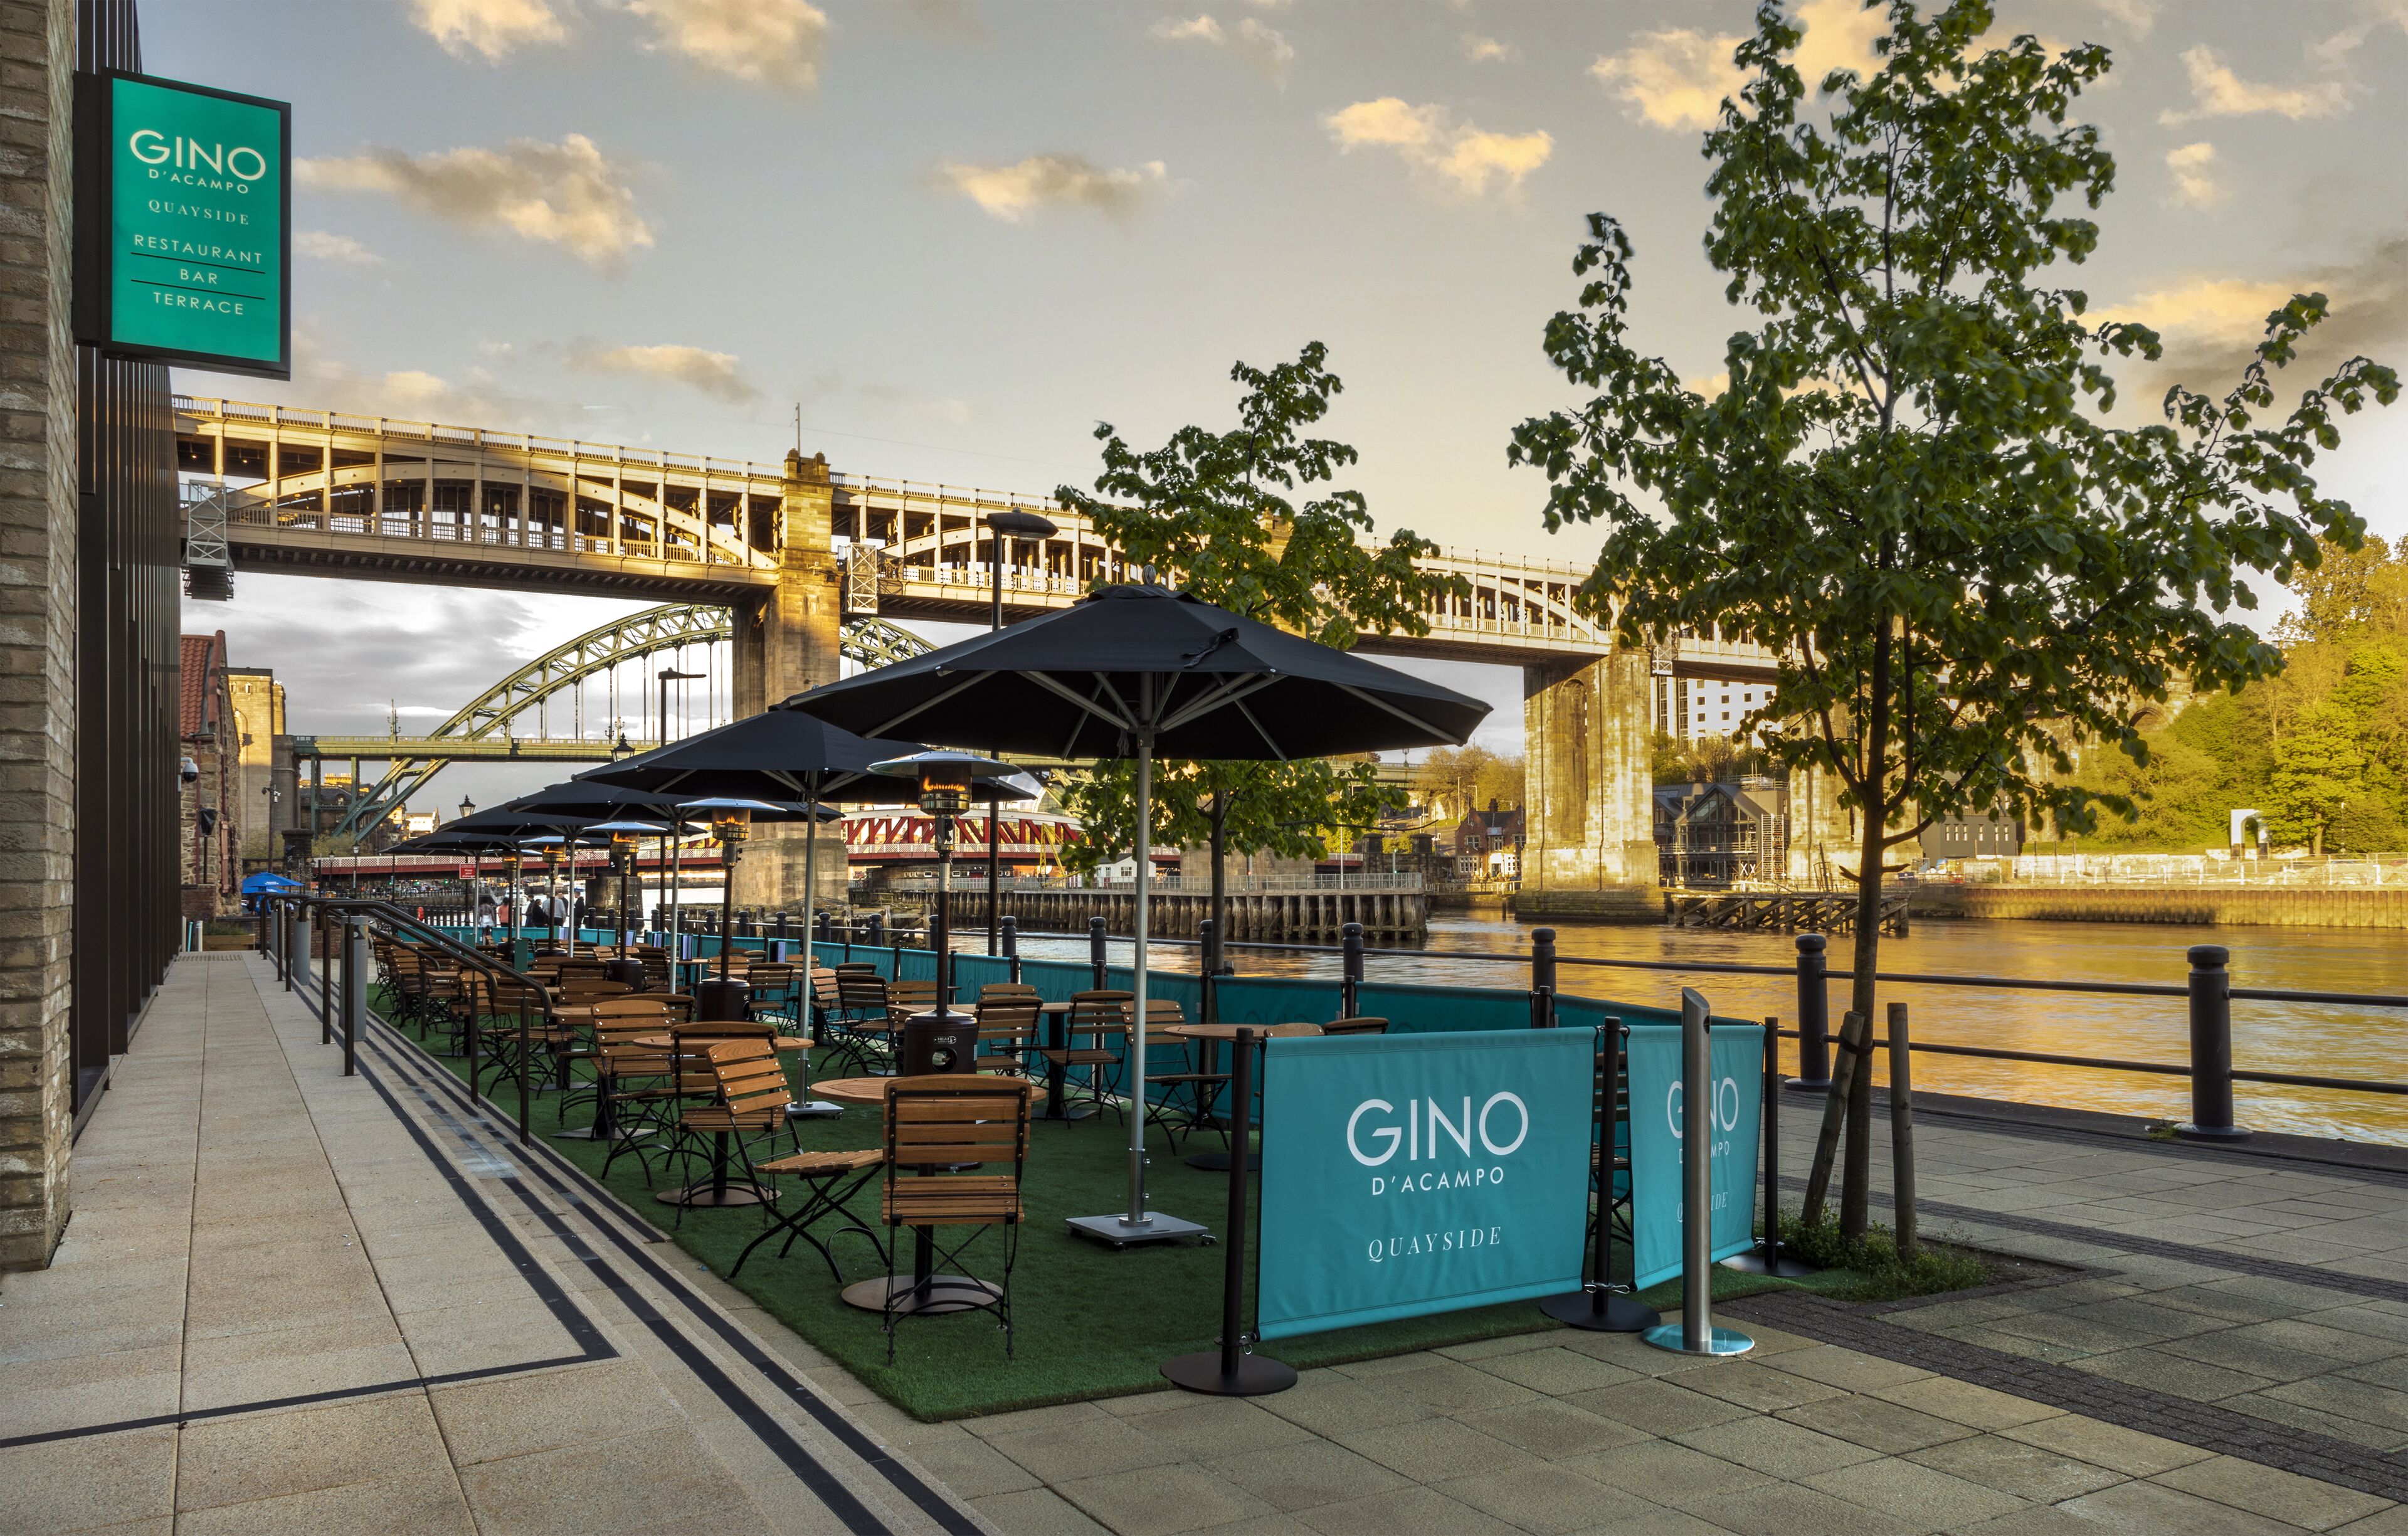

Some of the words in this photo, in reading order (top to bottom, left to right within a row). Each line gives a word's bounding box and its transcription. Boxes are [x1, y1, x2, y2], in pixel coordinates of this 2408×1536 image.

[129, 129, 267, 181] GINO
[149, 168, 249, 194] D'ACAMPO
[149, 199, 249, 225] QUAYSIDE
[134, 234, 262, 264] RESTAURANT
[180, 268, 218, 284] BAR
[153, 292, 244, 315] TERRACE
[1346, 1091, 1529, 1167] GINO
[1372, 1166, 1504, 1195] D'ACAMPO
[1368, 1226, 1502, 1263] QUAYSIDE
